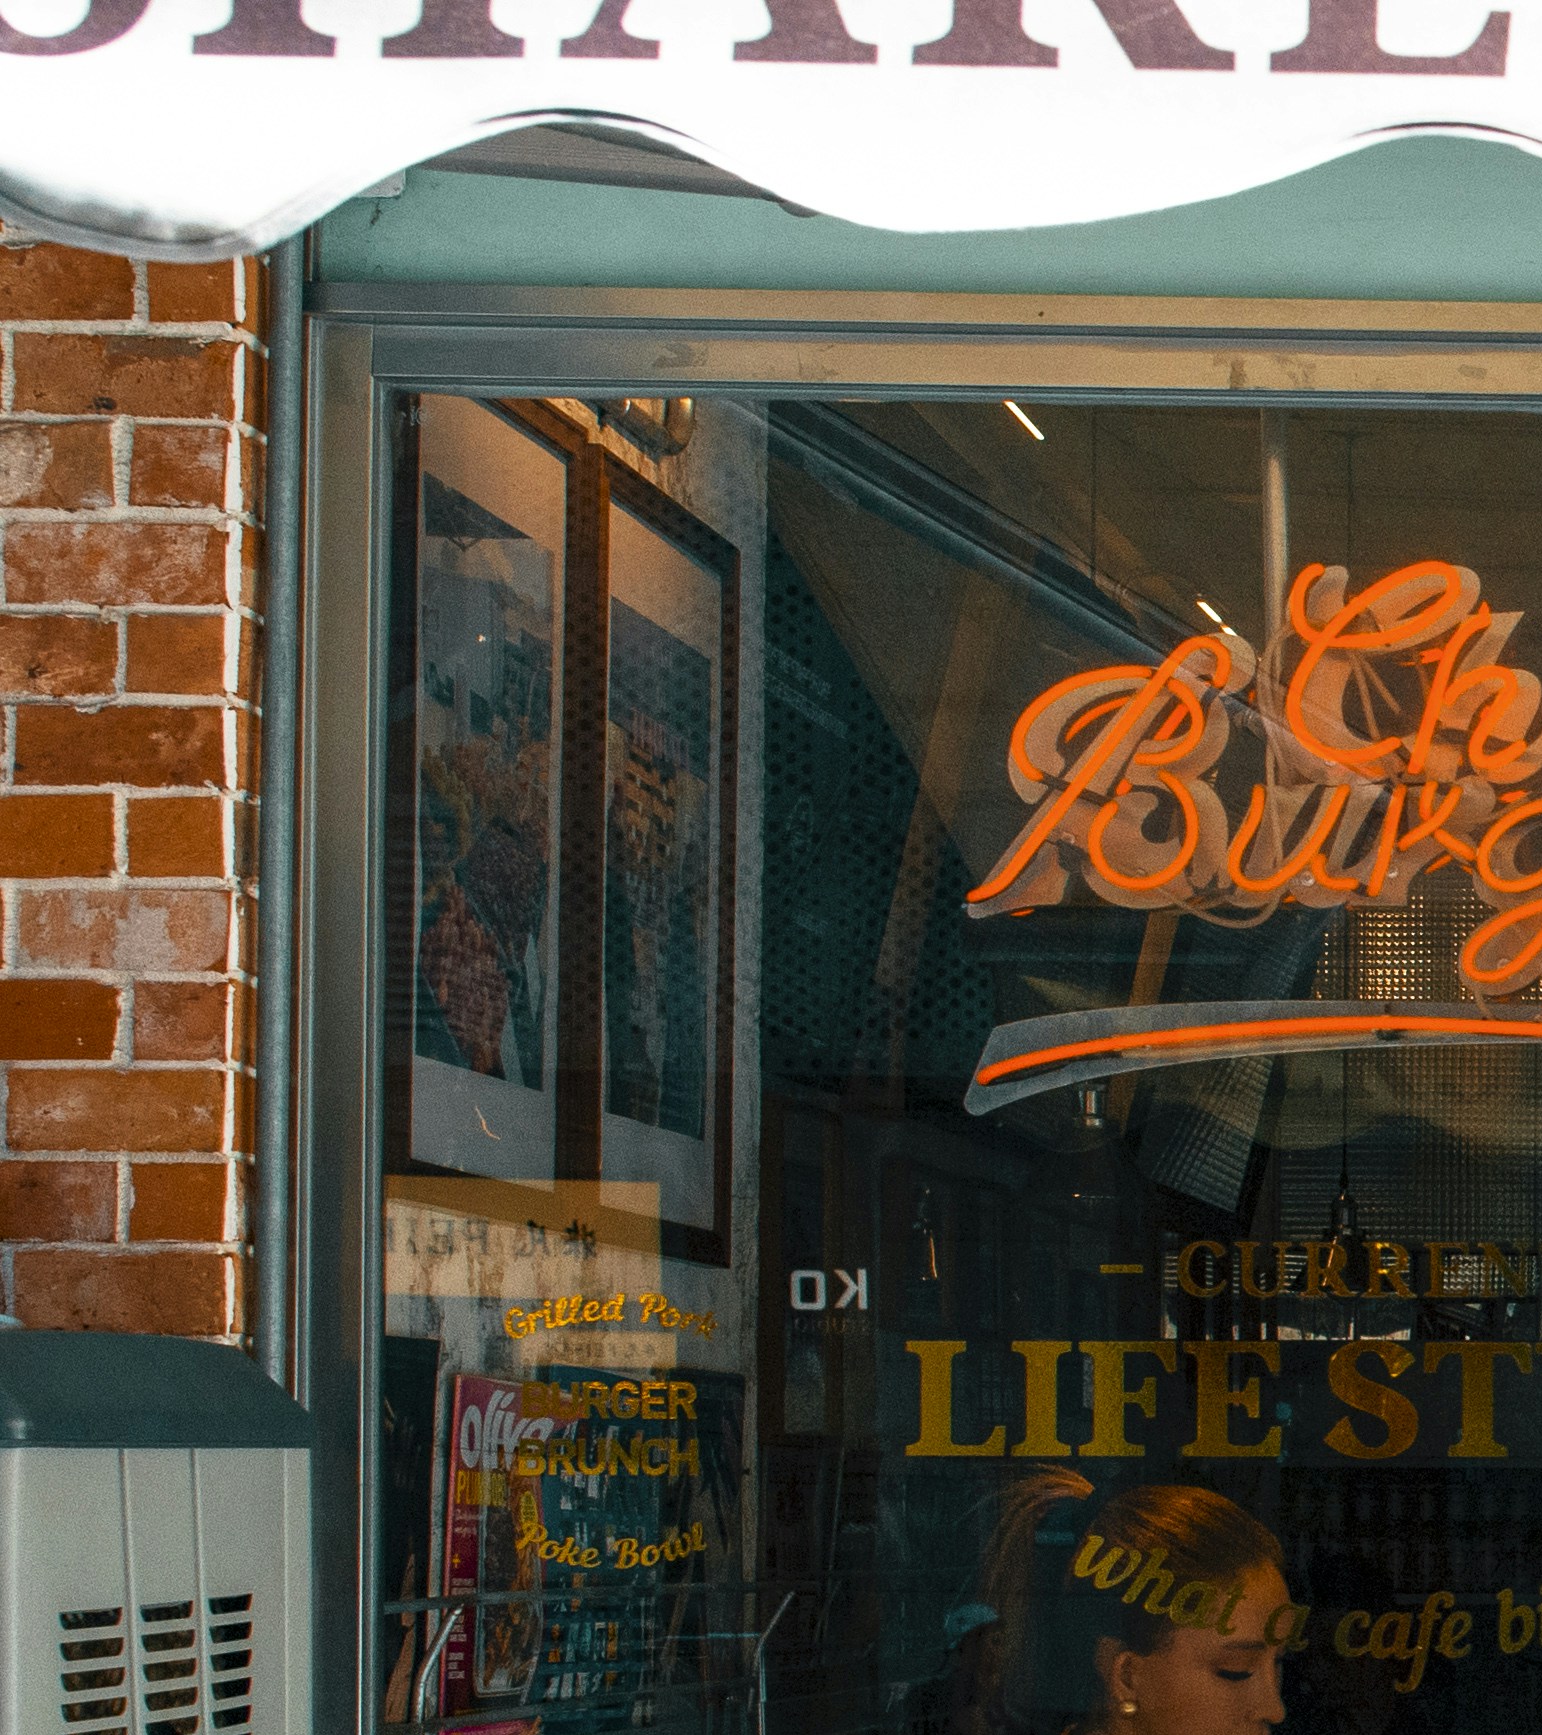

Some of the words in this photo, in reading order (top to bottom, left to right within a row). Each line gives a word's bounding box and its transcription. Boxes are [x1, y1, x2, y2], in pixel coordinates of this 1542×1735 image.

[503, 1292, 625, 1340] Grilled
[639, 1292, 718, 1341] Pork
[521, 1380, 698, 1421] BURGER
[904, 1339, 1284, 1458] LIFE
[516, 1438, 699, 1478] BRUNCH
[515, 1519, 603, 1569] Poke
[613, 1521, 707, 1571] Bowl
[1072, 1533, 1238, 1638] what
[1265, 1605, 1308, 1653] a
[1334, 1590, 1473, 1695] cafe
